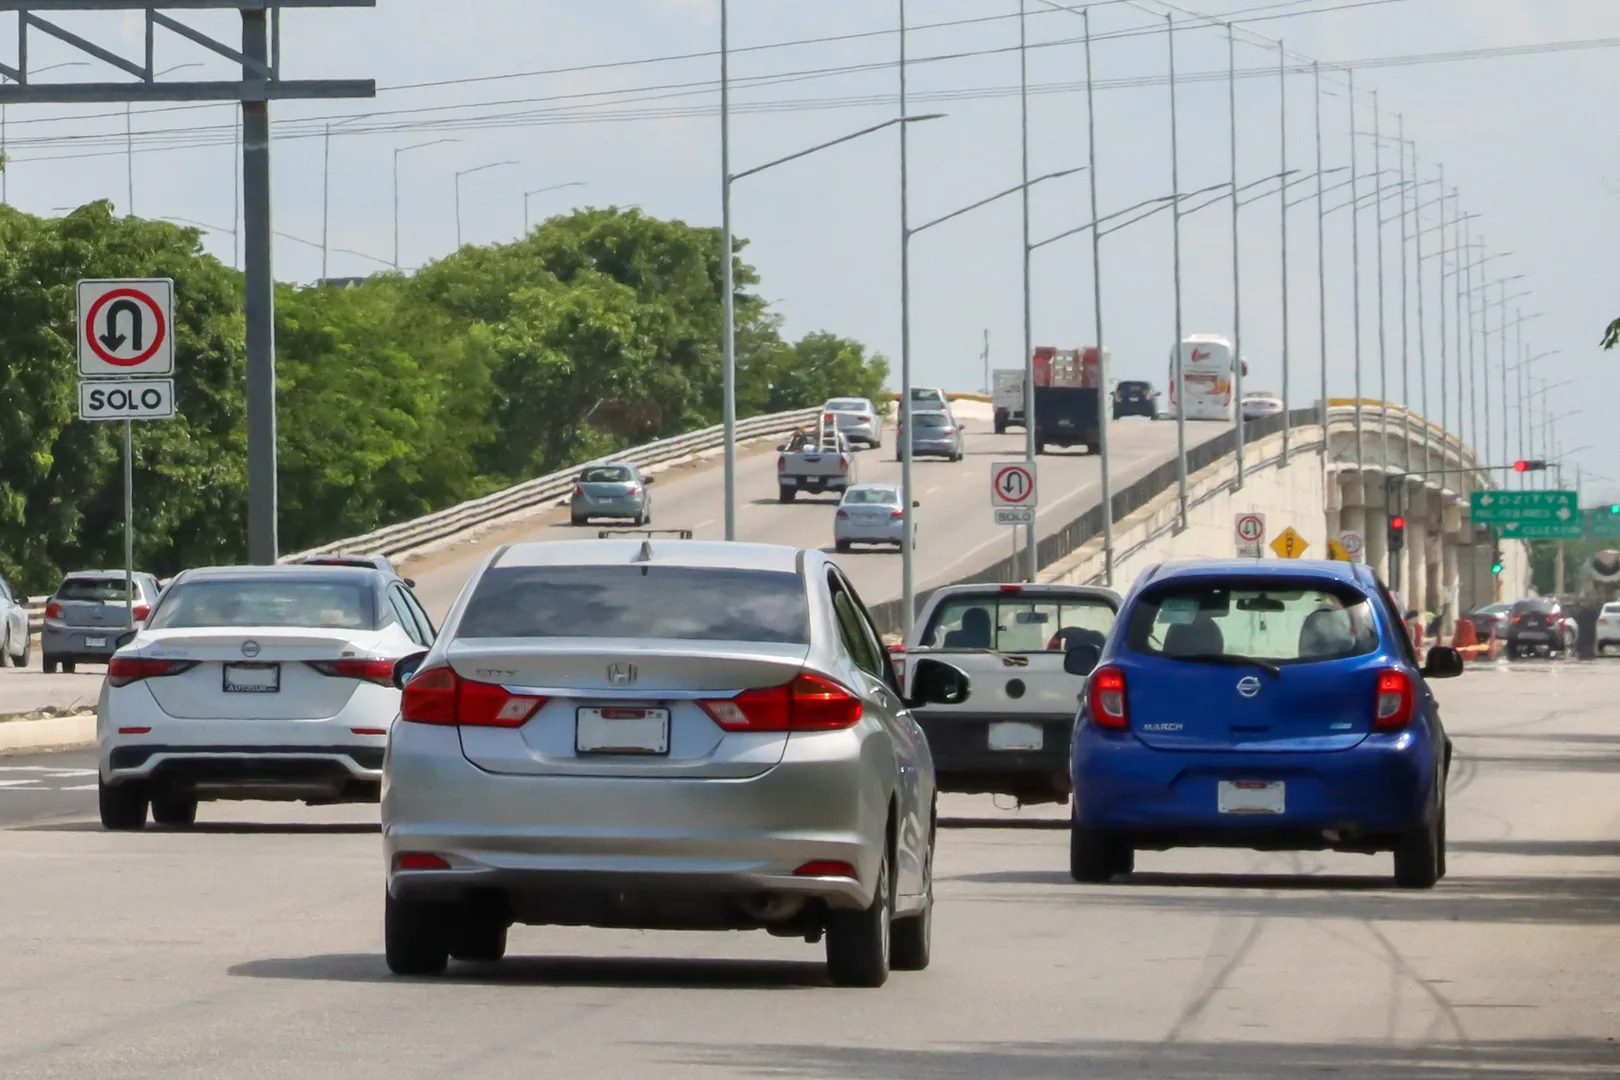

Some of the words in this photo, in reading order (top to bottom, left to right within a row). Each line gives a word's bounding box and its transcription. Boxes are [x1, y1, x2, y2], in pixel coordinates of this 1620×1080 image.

[89, 388, 161, 411] SOLO
[998, 512, 1031, 521] SOLO
[1143, 723, 1183, 731] MARCH
